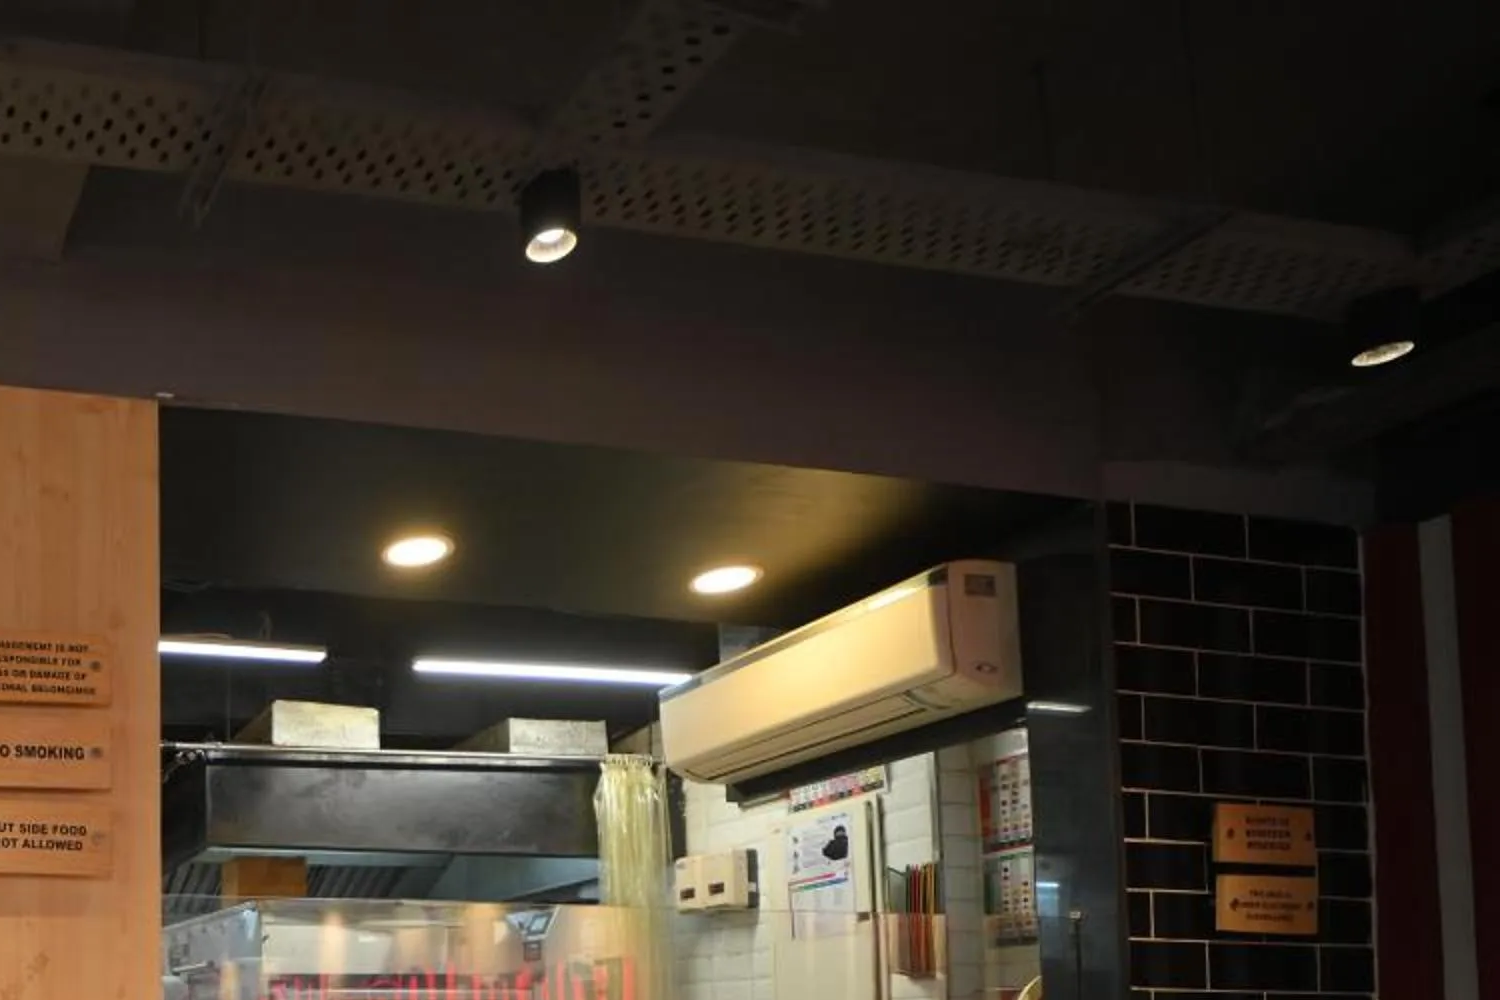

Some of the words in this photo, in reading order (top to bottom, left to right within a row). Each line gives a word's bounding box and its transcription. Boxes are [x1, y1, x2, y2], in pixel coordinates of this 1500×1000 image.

[55, 644, 65, 653] IS
[67, 644, 89, 653] NOT
[61, 657, 81, 666] FOR
[11, 668, 27, 678] OR
[29, 669, 70, 680] DAMAGE
[73, 672, 87, 681] OF
[14, 744, 85, 760] SMOKING
[19, 823, 49, 835] SIDE
[51, 824, 88, 836] FOOD
[21, 839, 84, 851] ALLOWED
